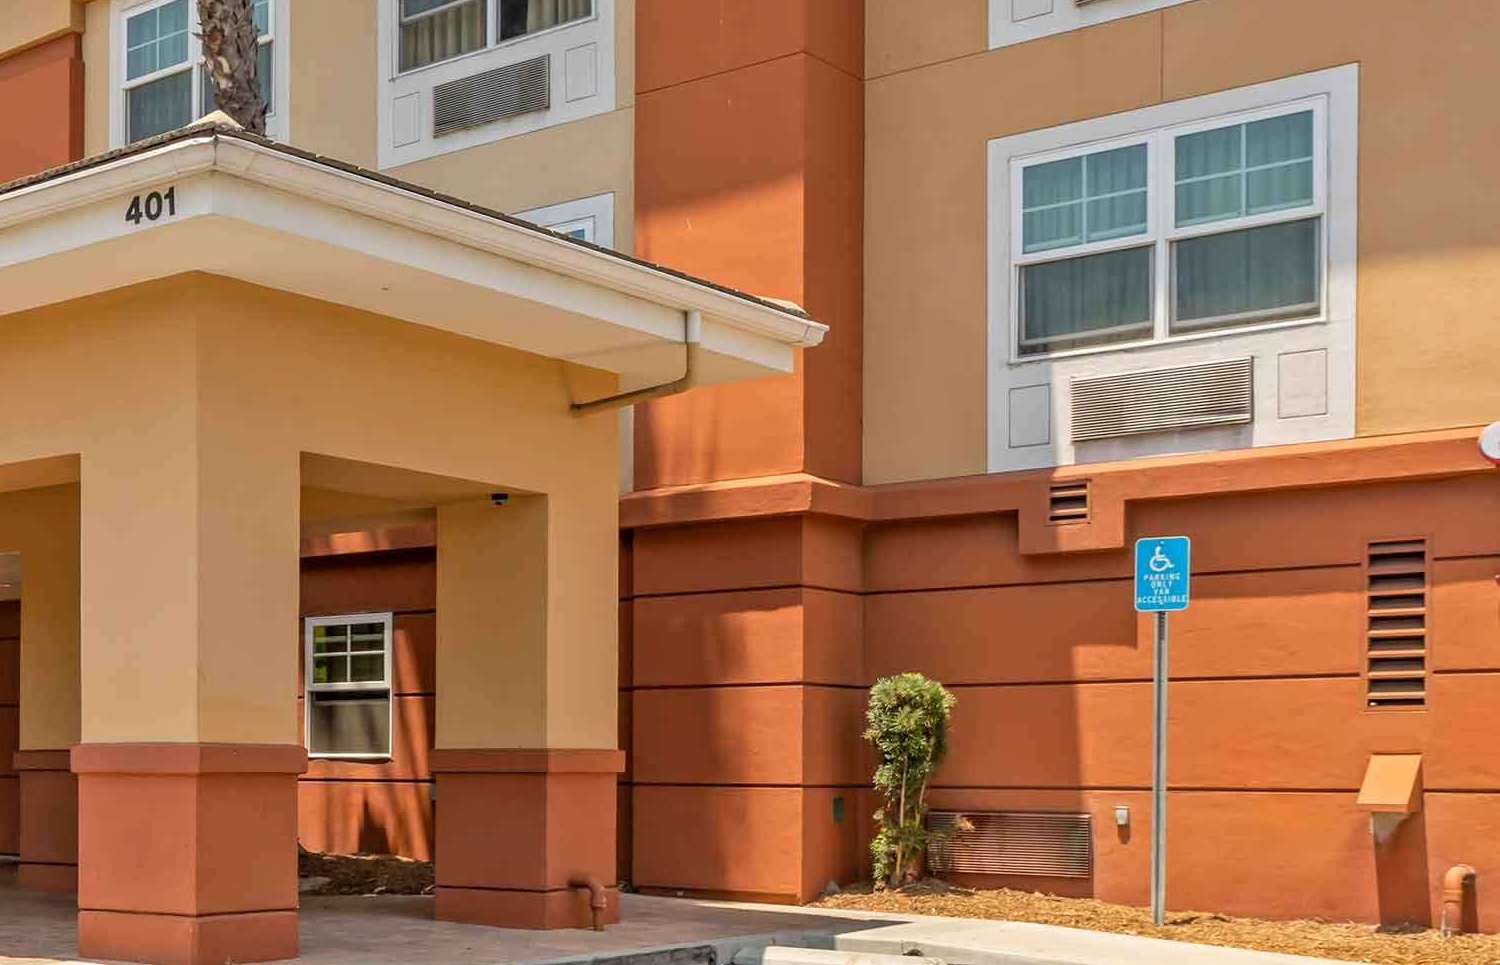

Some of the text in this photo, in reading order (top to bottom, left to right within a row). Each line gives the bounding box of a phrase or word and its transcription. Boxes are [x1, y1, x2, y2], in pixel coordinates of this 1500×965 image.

[125, 186, 175, 225] 401
[1143, 572, 1181, 581] PARKING
[1150, 580, 1173, 589] ONLY
[1153, 588, 1170, 596] VAN
[1137, 595, 1187, 604] ACCESSIBLE
